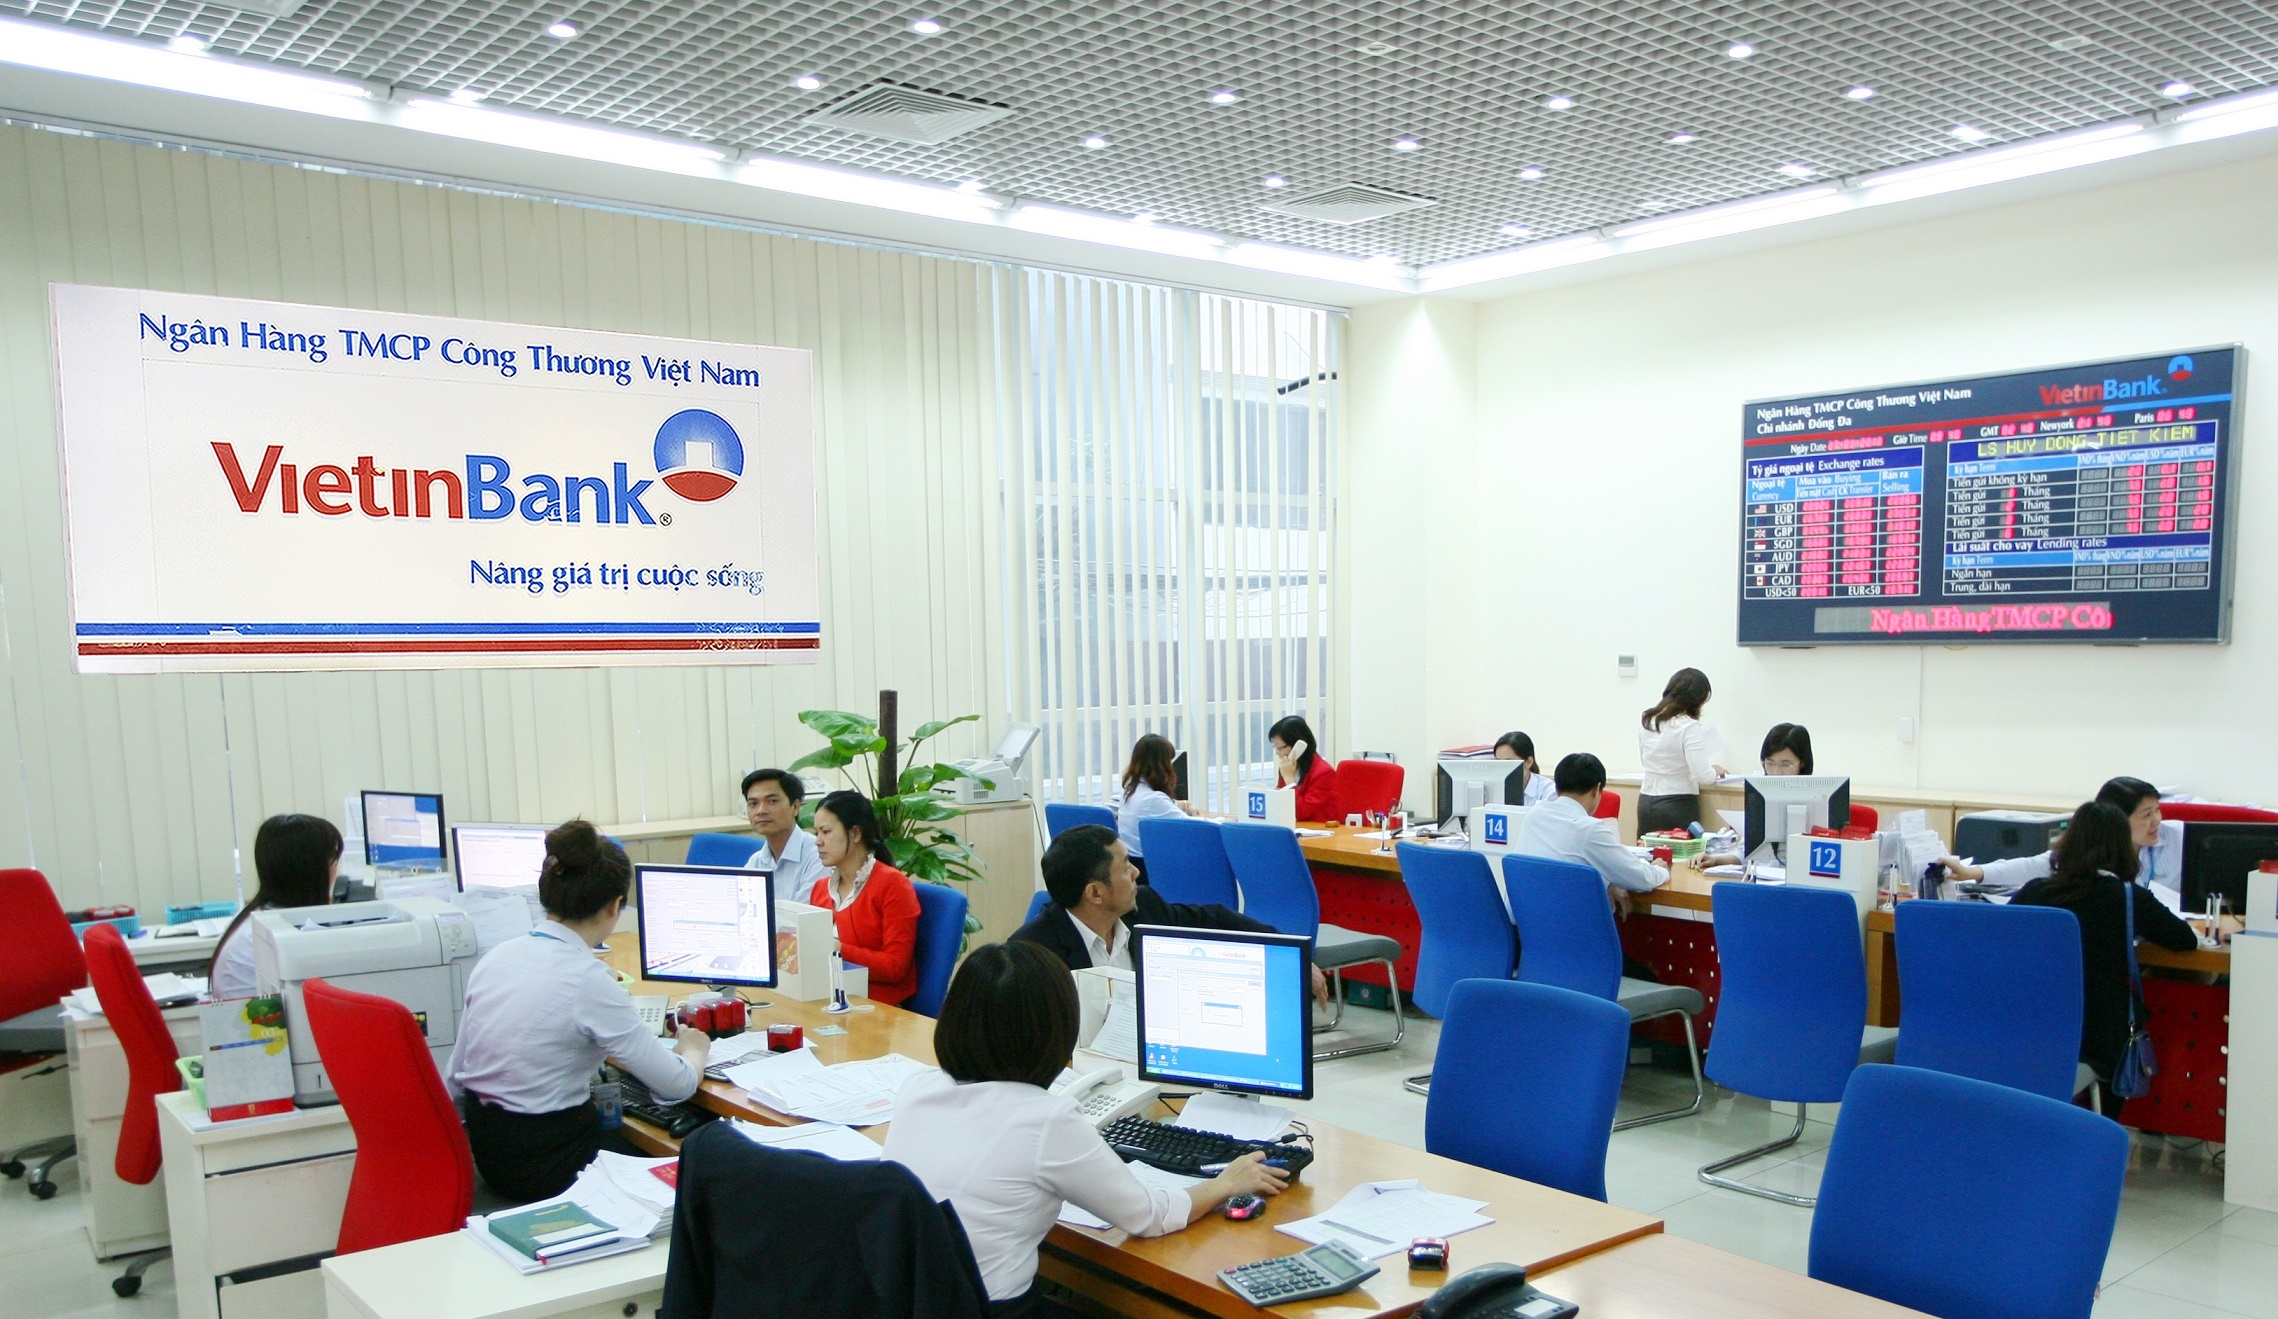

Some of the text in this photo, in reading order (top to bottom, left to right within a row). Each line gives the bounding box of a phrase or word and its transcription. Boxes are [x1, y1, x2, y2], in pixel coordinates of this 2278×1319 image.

[139, 313, 760, 387] Ngân Hàng TMCP Công Thương Việt Nam
[2039, 375, 2162, 406] VietinBank
[1757, 409, 1783, 421] Ngân
[1785, 405, 1812, 418] Hàng
[1813, 401, 1844, 414] TMCP
[1846, 397, 1874, 411] Công
[1918, 389, 1941, 404] Việt
[1944, 388, 1972, 400] Nam
[2134, 412, 2155, 424] Paris
[1775, 419, 1805, 433] nhánh
[1808, 416, 1835, 431] Đống
[1837, 416, 1852, 427] Đa
[2040, 417, 2075, 432] Newyork
[1980, 425, 1999, 437] GMT
[1908, 433, 1928, 443] Time
[1977, 425, 2195, 458] LS HUY DONG TIET KIEM
[1790, 444, 1809, 456] Ngày
[1810, 442, 1827, 452] Date
[1818, 458, 1860, 471] Exchange
[1862, 457, 1884, 467] rates
[1834, 474, 1862, 485] Buying
[1899, 470, 1909, 479] ra
[1988, 474, 2016, 487] không
[2030, 472, 2047, 482] hạn
[211, 441, 657, 525] VietinBank
[1882, 482, 1910, 494] Selling
[2022, 486, 2051, 498] Tháng
[1774, 503, 1794, 514] USD
[2022, 499, 2050, 511] Tháng
[1774, 515, 1793, 525] EUR
[2021, 513, 2050, 525] Tháng
[1774, 527, 1793, 537] GBP
[2021, 526, 2049, 538] Tháng
[1773, 539, 1793, 550] SGD
[1992, 539, 2013, 551] cho
[2015, 540, 2033, 552] vay
[2037, 537, 2079, 550] Lending
[2081, 536, 2107, 548] rates
[1772, 551, 1793, 561] AUD
[1775, 563, 1790, 574] JPY
[470, 560, 765, 596] Nâng giá trị cuộc sống
[1771, 574, 1792, 585] CAD
[1765, 587, 1797, 597] USD<50
[1848, 585, 1881, 596] EUR<50
[1870, 608, 1930, 634] Ngân
[1250, 796, 1264, 812] 15
[1487, 818, 1504, 836] 14
[1813, 847, 1837, 868] 12
[1213, 1082, 1229, 1090] DELL
